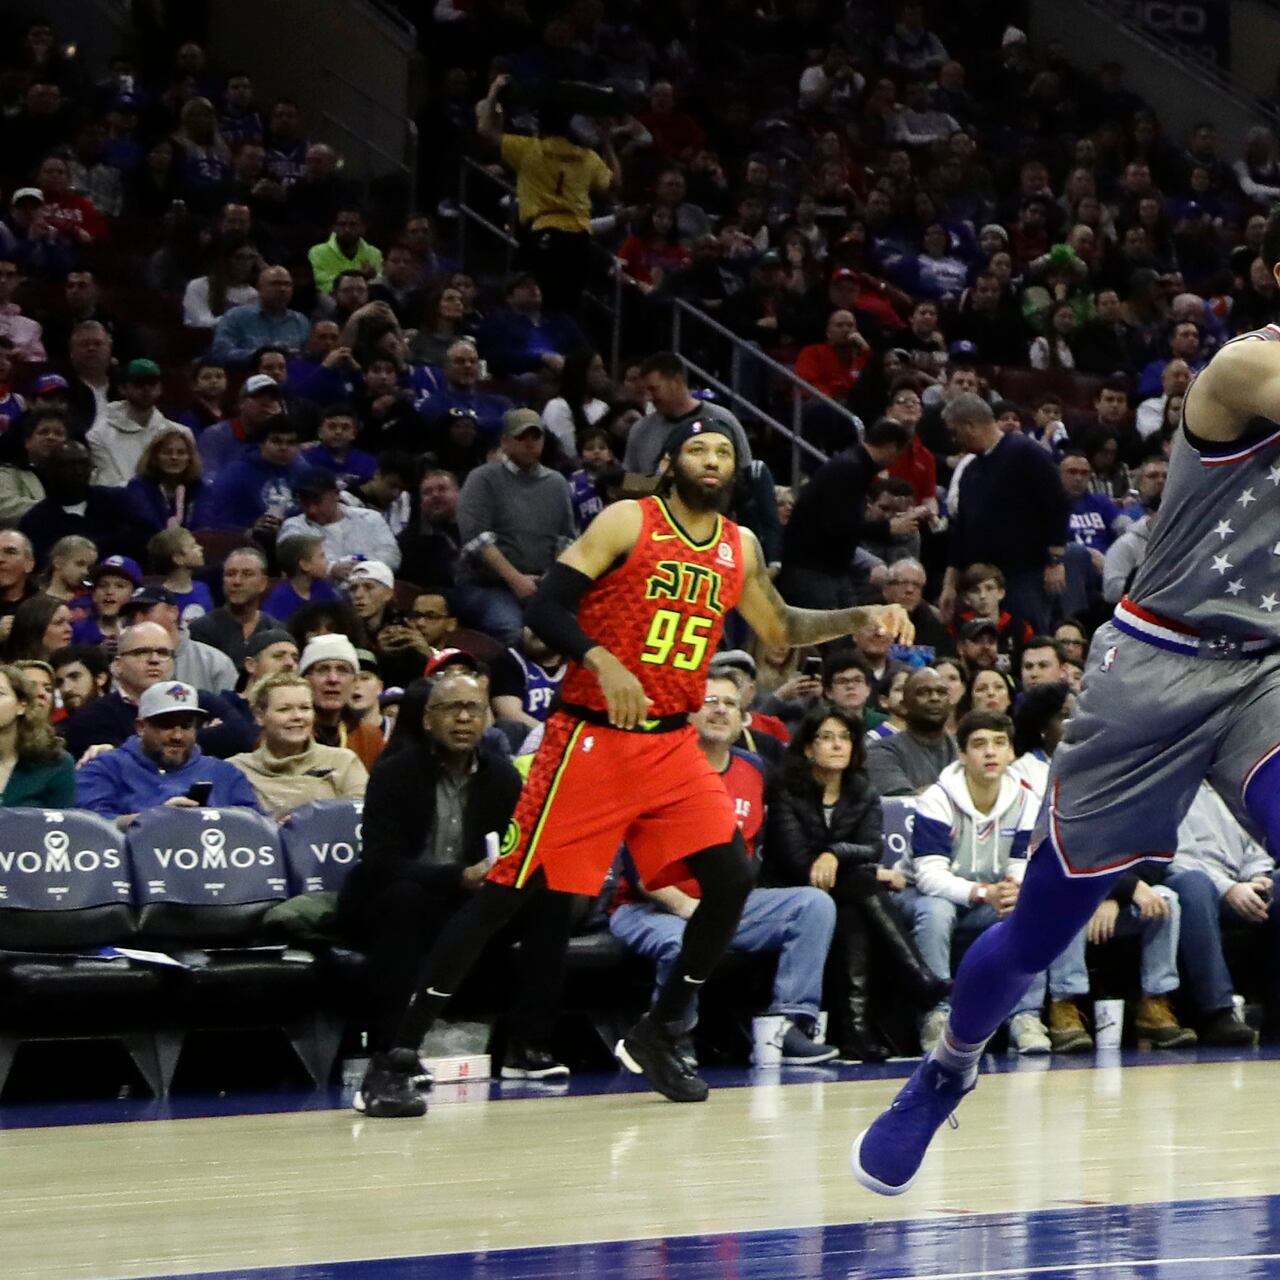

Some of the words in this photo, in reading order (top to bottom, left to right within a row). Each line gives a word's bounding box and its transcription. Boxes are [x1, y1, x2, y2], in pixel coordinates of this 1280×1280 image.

[645, 561, 725, 616] ATL
[641, 609, 713, 671] 95
[0, 848, 121, 873] VOMOS
[153, 846, 276, 870] VOMOS
